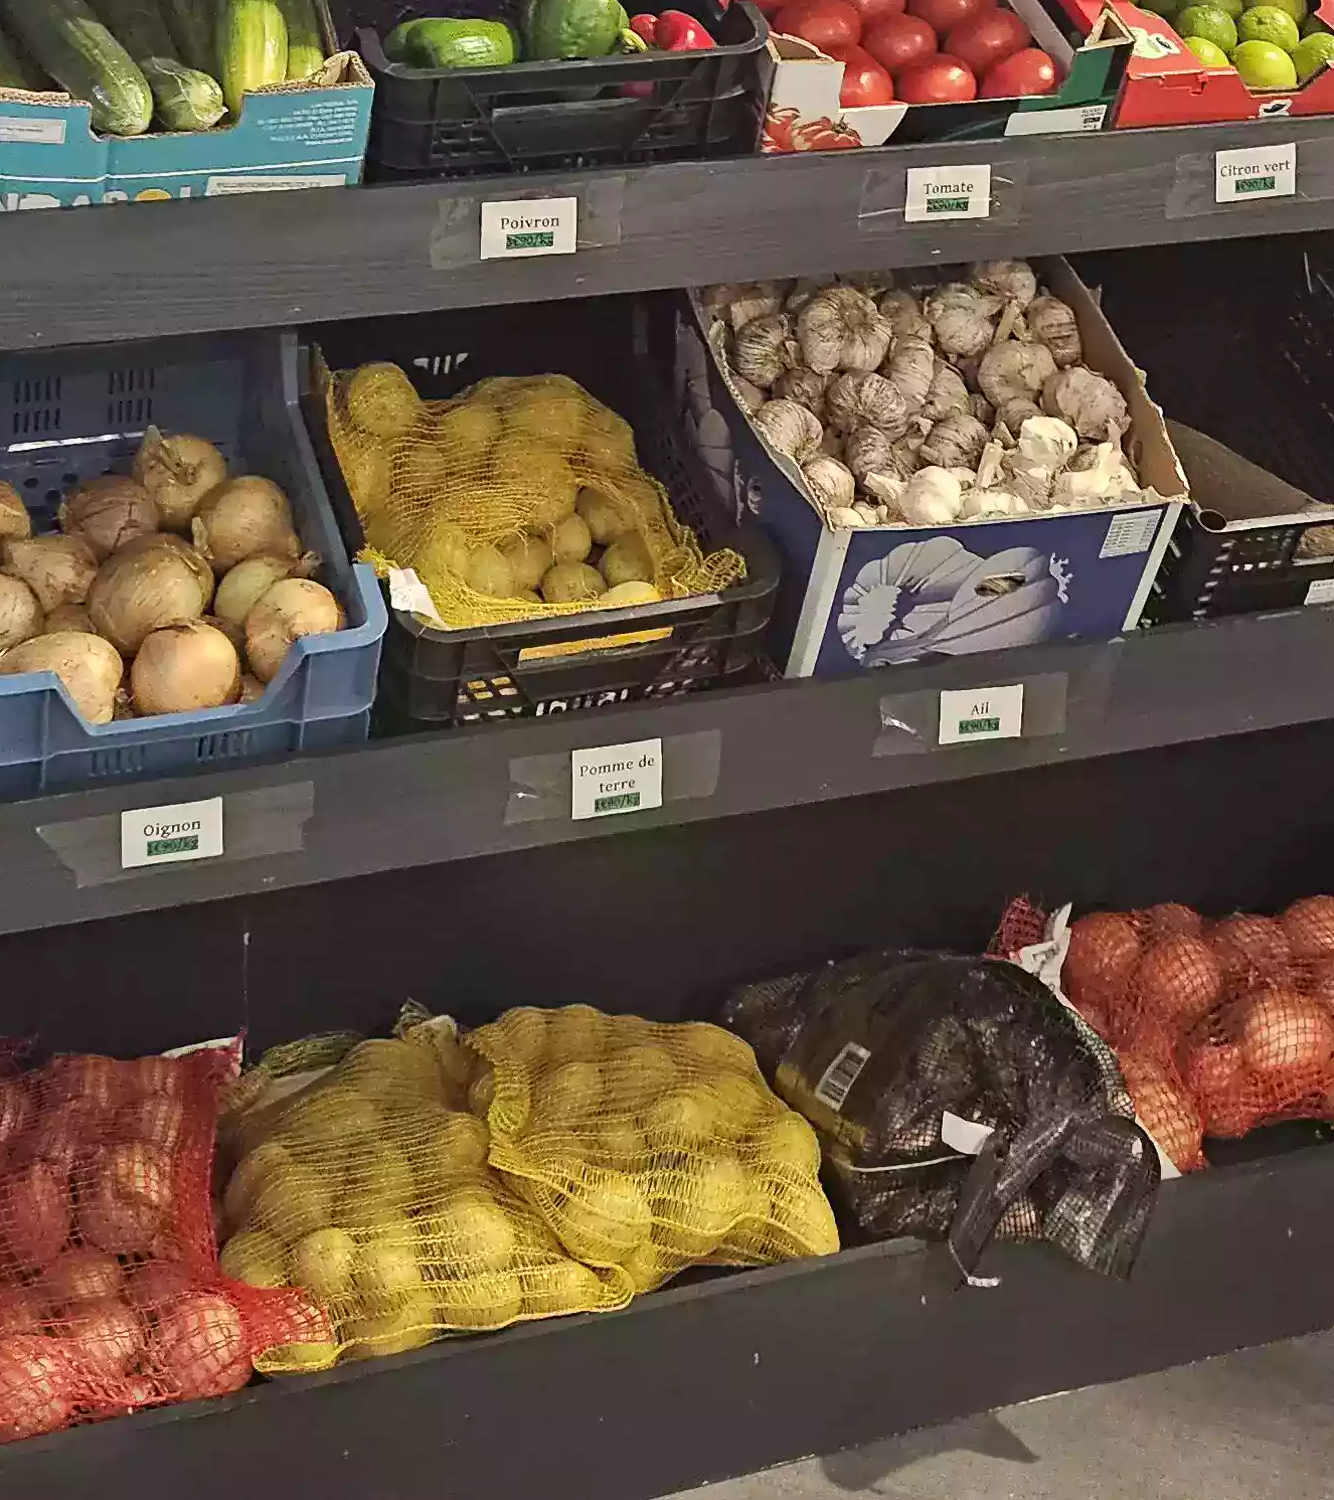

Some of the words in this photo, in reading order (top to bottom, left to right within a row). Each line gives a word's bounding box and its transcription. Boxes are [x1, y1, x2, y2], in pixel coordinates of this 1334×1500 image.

[1220, 164, 1260, 178] Citron
[1263, 159, 1291, 172] vert
[922, 182, 974, 195] Tomate
[500, 215, 560, 230] Poivron
[970, 701, 989, 716] Ail
[579, 759, 634, 777] Pomme
[638, 754, 655, 768] de
[599, 779, 636, 794] terre
[143, 820, 202, 839] Oignon
